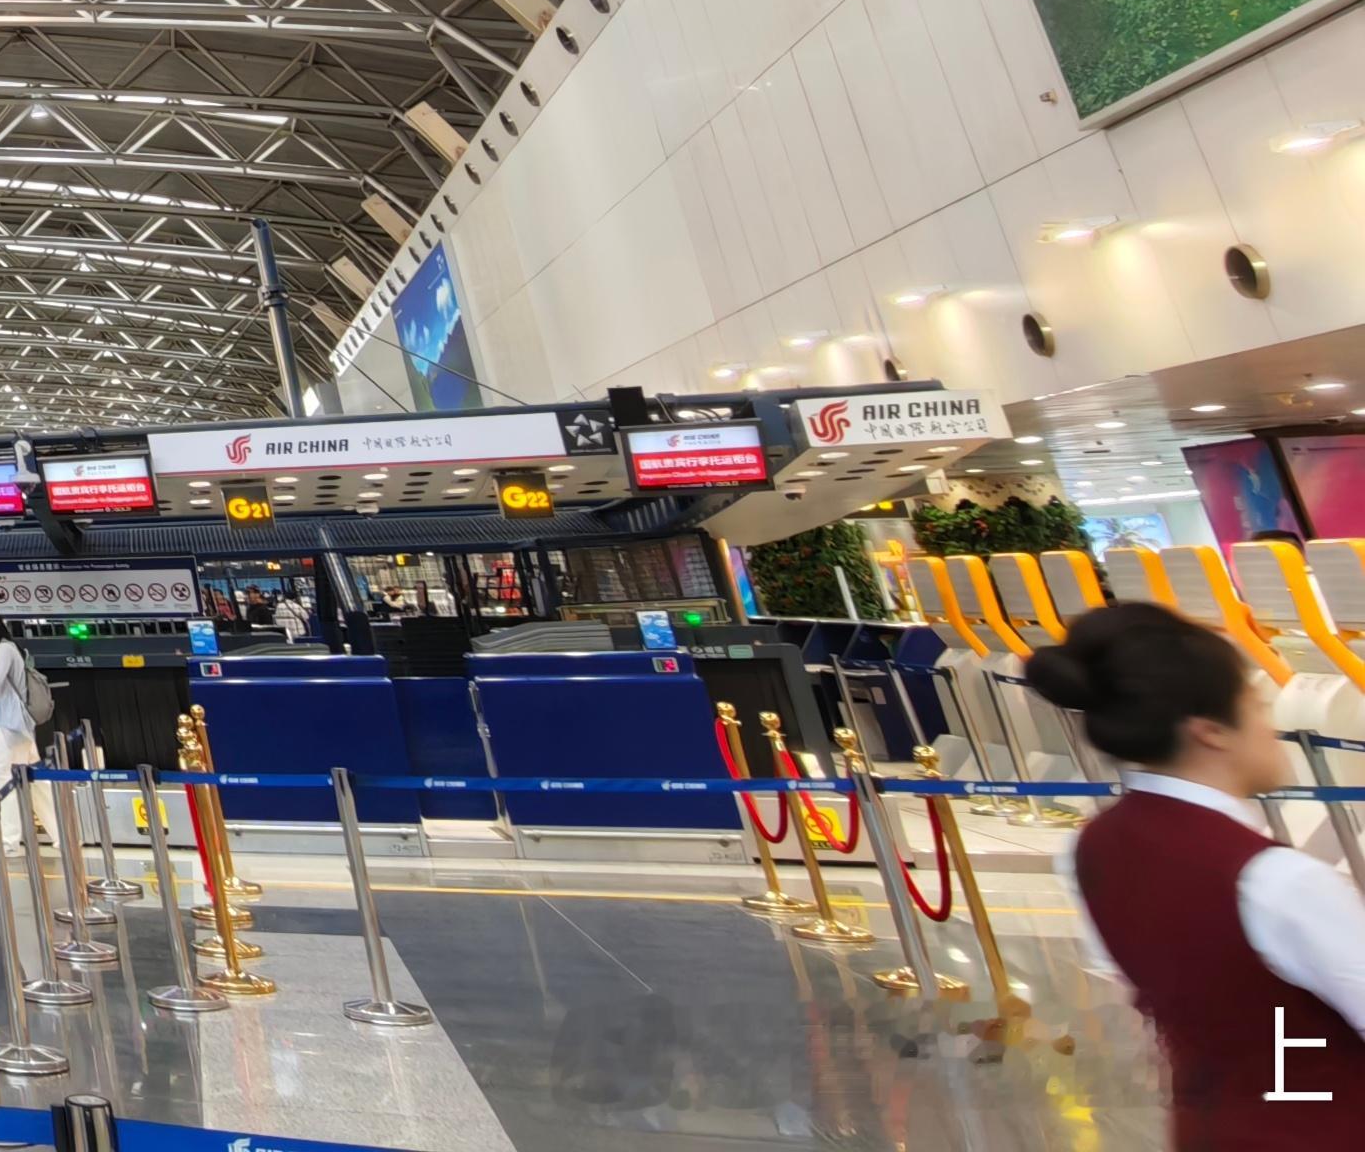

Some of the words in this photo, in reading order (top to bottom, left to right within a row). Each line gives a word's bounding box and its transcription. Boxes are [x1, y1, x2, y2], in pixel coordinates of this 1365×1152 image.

[862, 403, 901, 421] AIR
[907, 398, 981, 418] CHINA
[265, 441, 294, 455] AIR
[298, 438, 349, 454] CHINA
[228, 497, 270, 520] G21
[502, 485, 550, 509] G22
